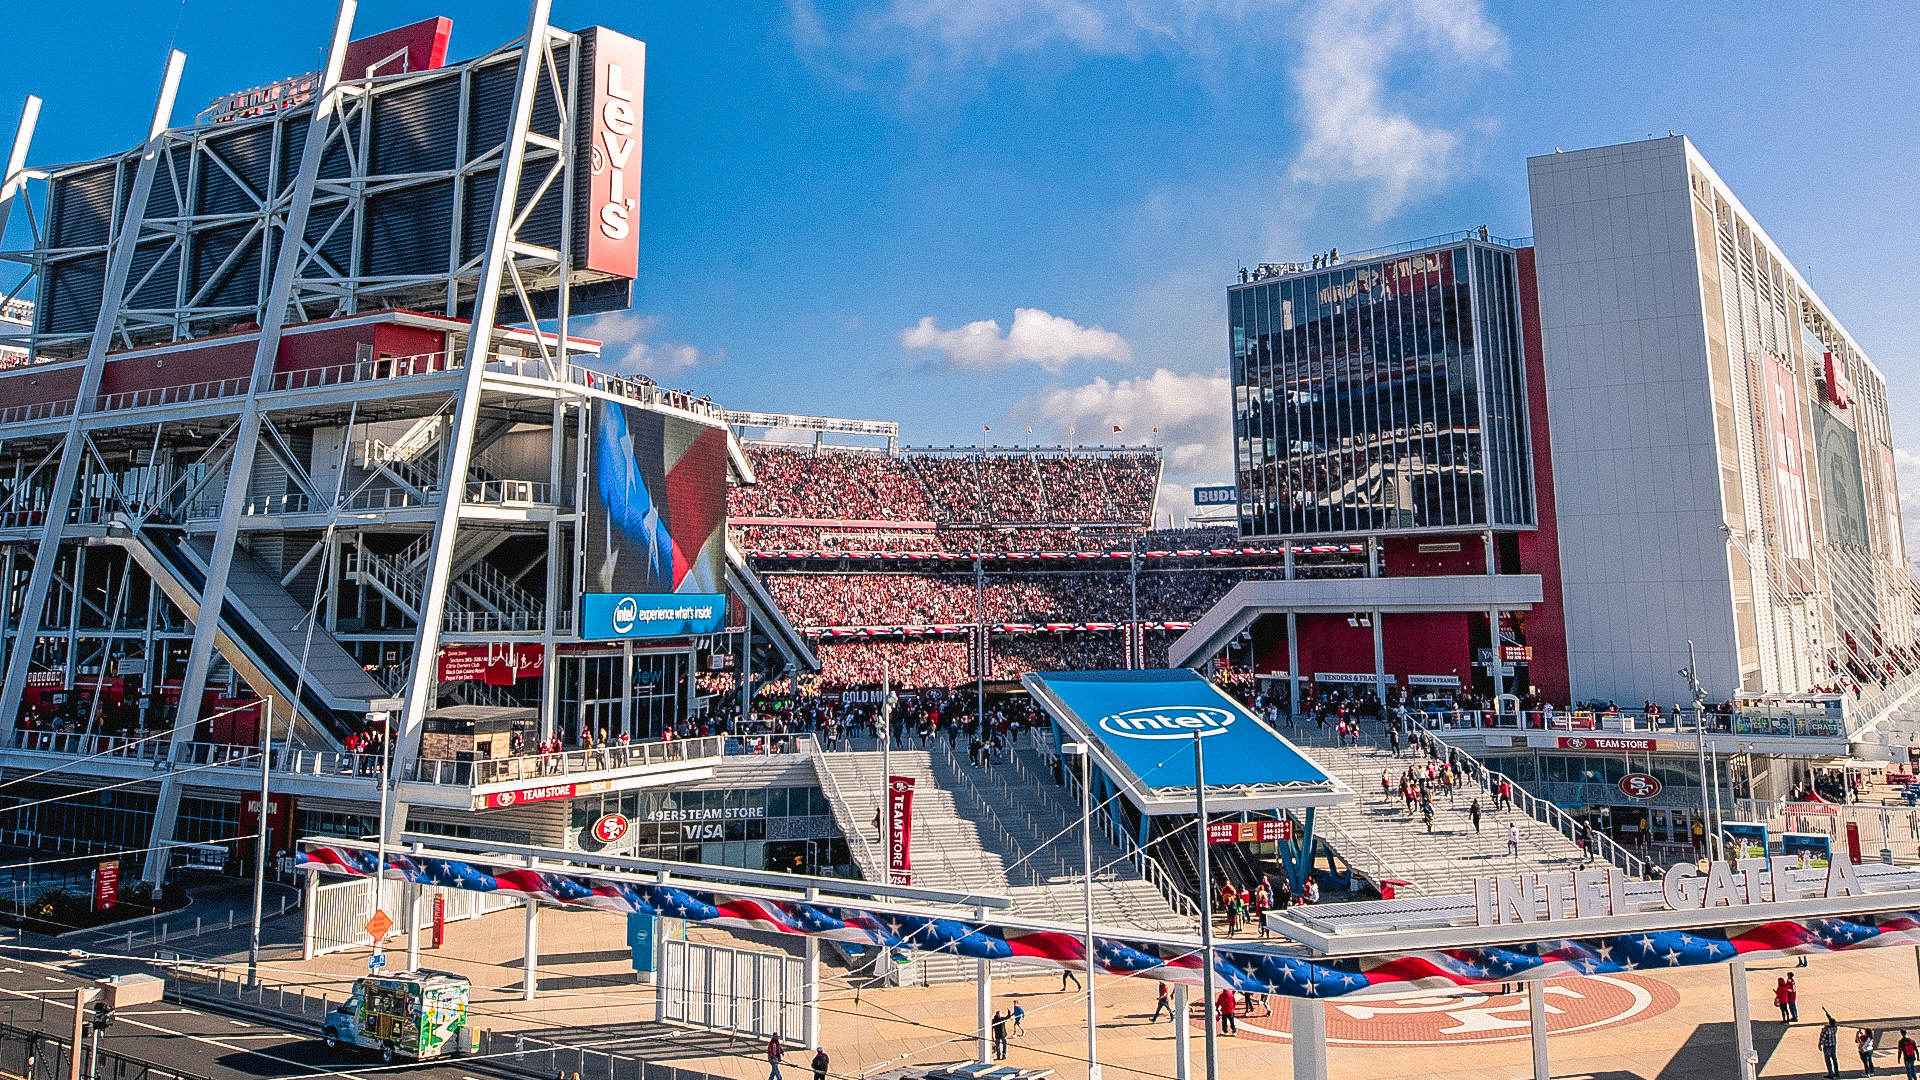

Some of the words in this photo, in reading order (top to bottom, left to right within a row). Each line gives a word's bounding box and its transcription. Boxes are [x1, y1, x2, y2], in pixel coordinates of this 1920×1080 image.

[616, 604, 634, 622] intel
[638, 607, 675, 624] experience
[675, 606, 694, 621] what's
[1110, 712, 1219, 730] intel
[1594, 739, 1619, 748] TEAM
[1620, 740, 1649, 749] STORE
[1675, 741, 1696, 750] VISA
[522, 787, 546, 800] TEAM
[546, 784, 571, 798] STORE
[647, 810, 687, 822] 49ERS
[687, 808, 722, 820] TEAM
[724, 806, 764, 818] STORE
[893, 794, 905, 830] TEAM
[682, 824, 724, 840] VISA
[892, 830, 903, 867] STORE
[1474, 868, 1640, 927] INTEL
[1661, 855, 1800, 911] GATE
[1824, 852, 1862, 899] A
